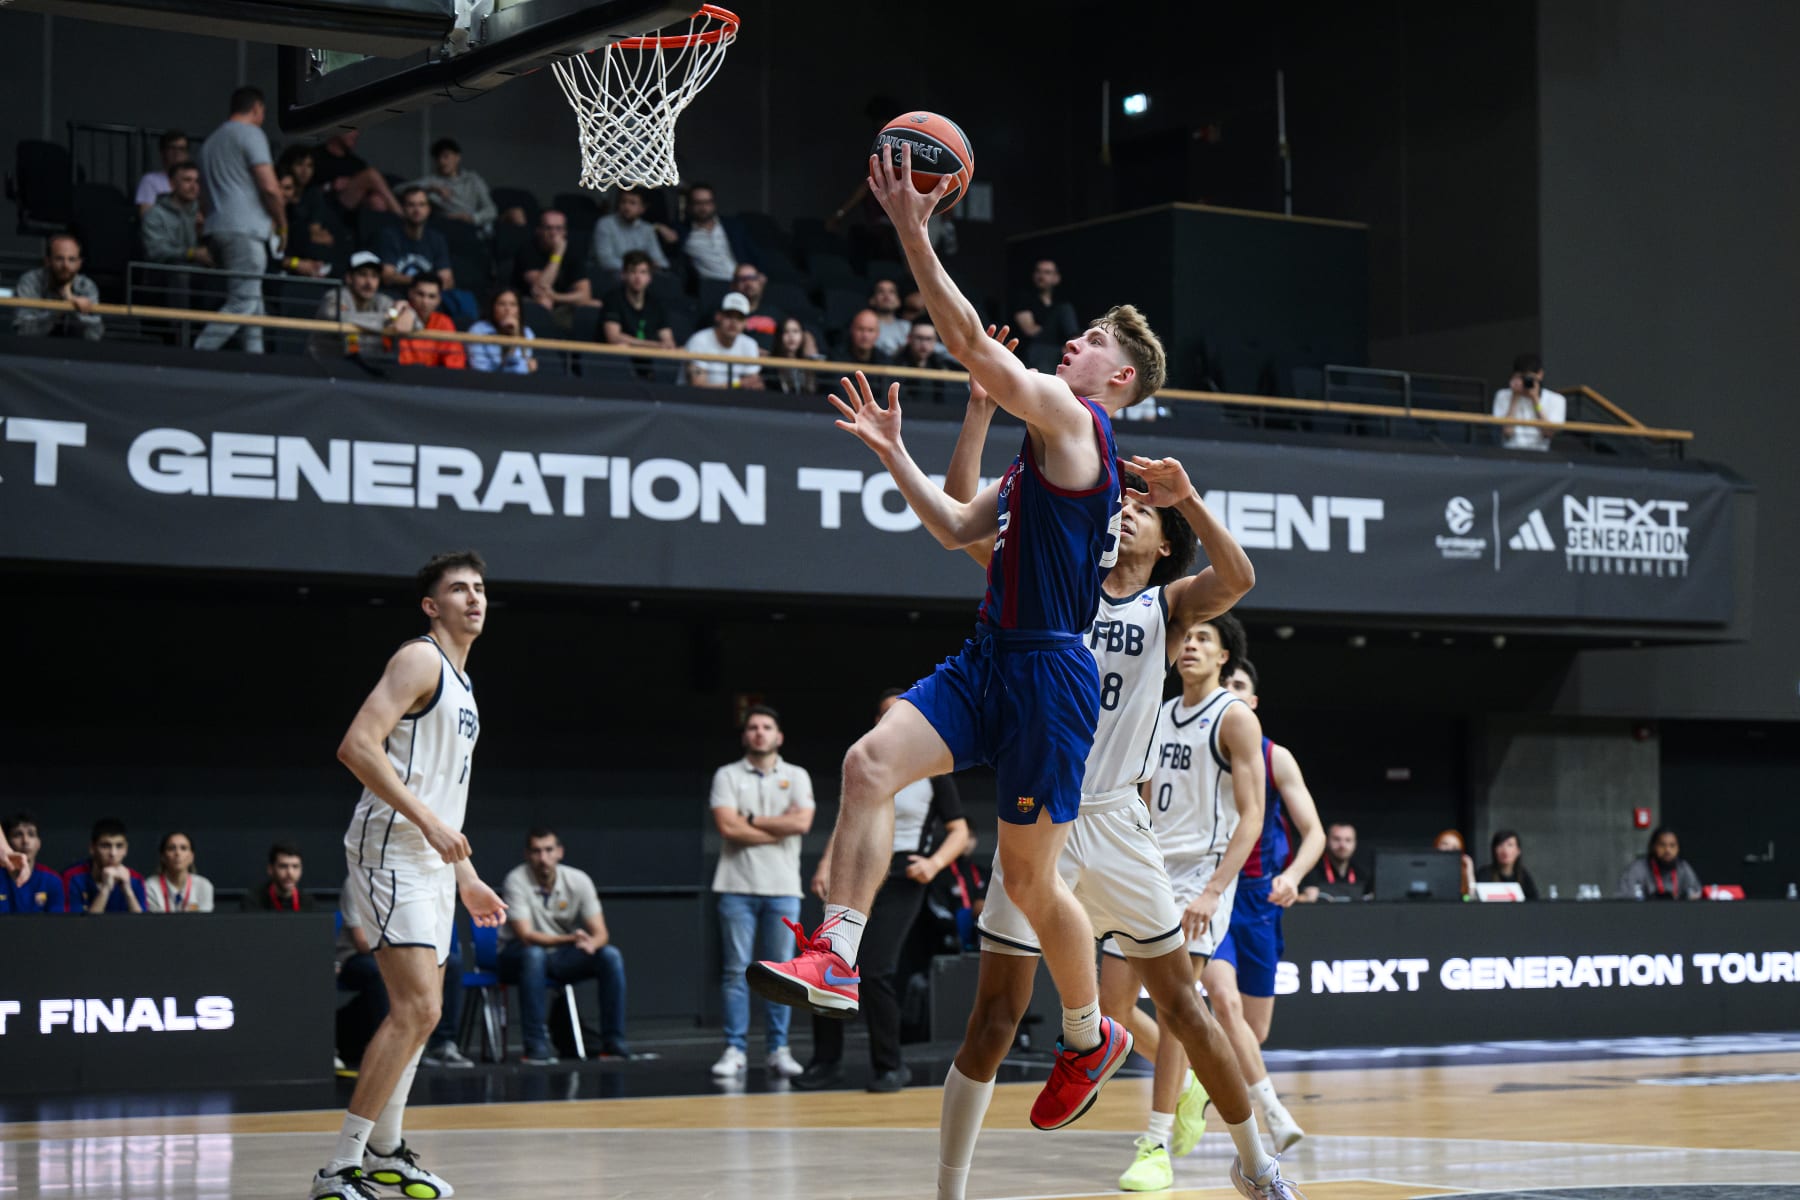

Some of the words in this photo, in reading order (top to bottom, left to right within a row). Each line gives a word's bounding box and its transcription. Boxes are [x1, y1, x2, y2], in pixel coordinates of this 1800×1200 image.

[127, 427, 767, 526] GENERATION
[1563, 494, 1689, 529] NEXT
[1565, 526, 1689, 554] GENERATION
[1100, 671, 1124, 711] 8
[1310, 958, 1430, 994] NEXT
[1440, 953, 1684, 991] GENERATION
[1692, 951, 1800, 985] TOUR
[39, 995, 235, 1035] FINALS
